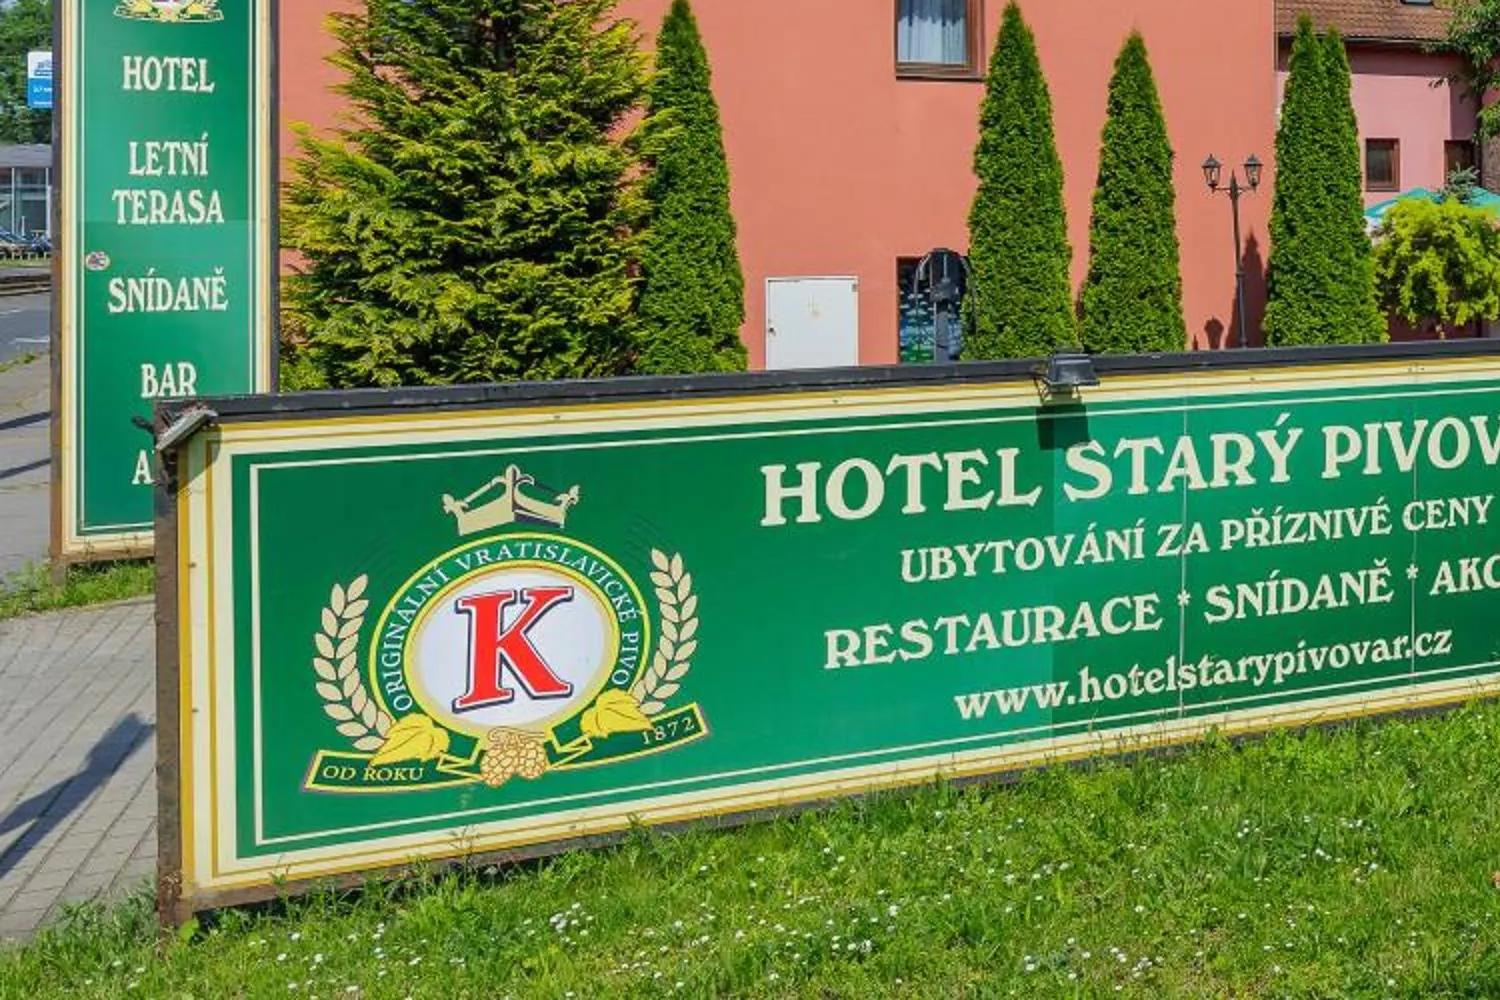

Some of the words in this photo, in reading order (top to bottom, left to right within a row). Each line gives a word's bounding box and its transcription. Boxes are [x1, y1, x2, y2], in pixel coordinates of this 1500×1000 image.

[122, 56, 215, 93] HOTEL
[128, 132, 210, 178] LETNÍ
[112, 190, 225, 226] TERASA
[107, 266, 229, 314] SNÍDANĚ
[140, 361, 198, 399] BAR
[760, 447, 1043, 527] HOTEL
[1062, 412, 1304, 503] STARÝ
[900, 518, 1147, 583] UBYTOVÁNÍ
[1155, 521, 1211, 558] ZA
[1220, 496, 1394, 551] PŘÍZNIVÉ
[1402, 494, 1495, 532] CENY
[823, 592, 1165, 670] RESTAURACE
[1203, 557, 1395, 624] SNÍDANĚ
[451, 585, 575, 714] K
[611, 630, 640, 686] PIVO
[952, 629, 1454, 722] www.hotelstarypivovar.cz
[322, 765, 357, 780] OD
[362, 766, 425, 781] ROKU
[641, 716, 696, 745] 1872
